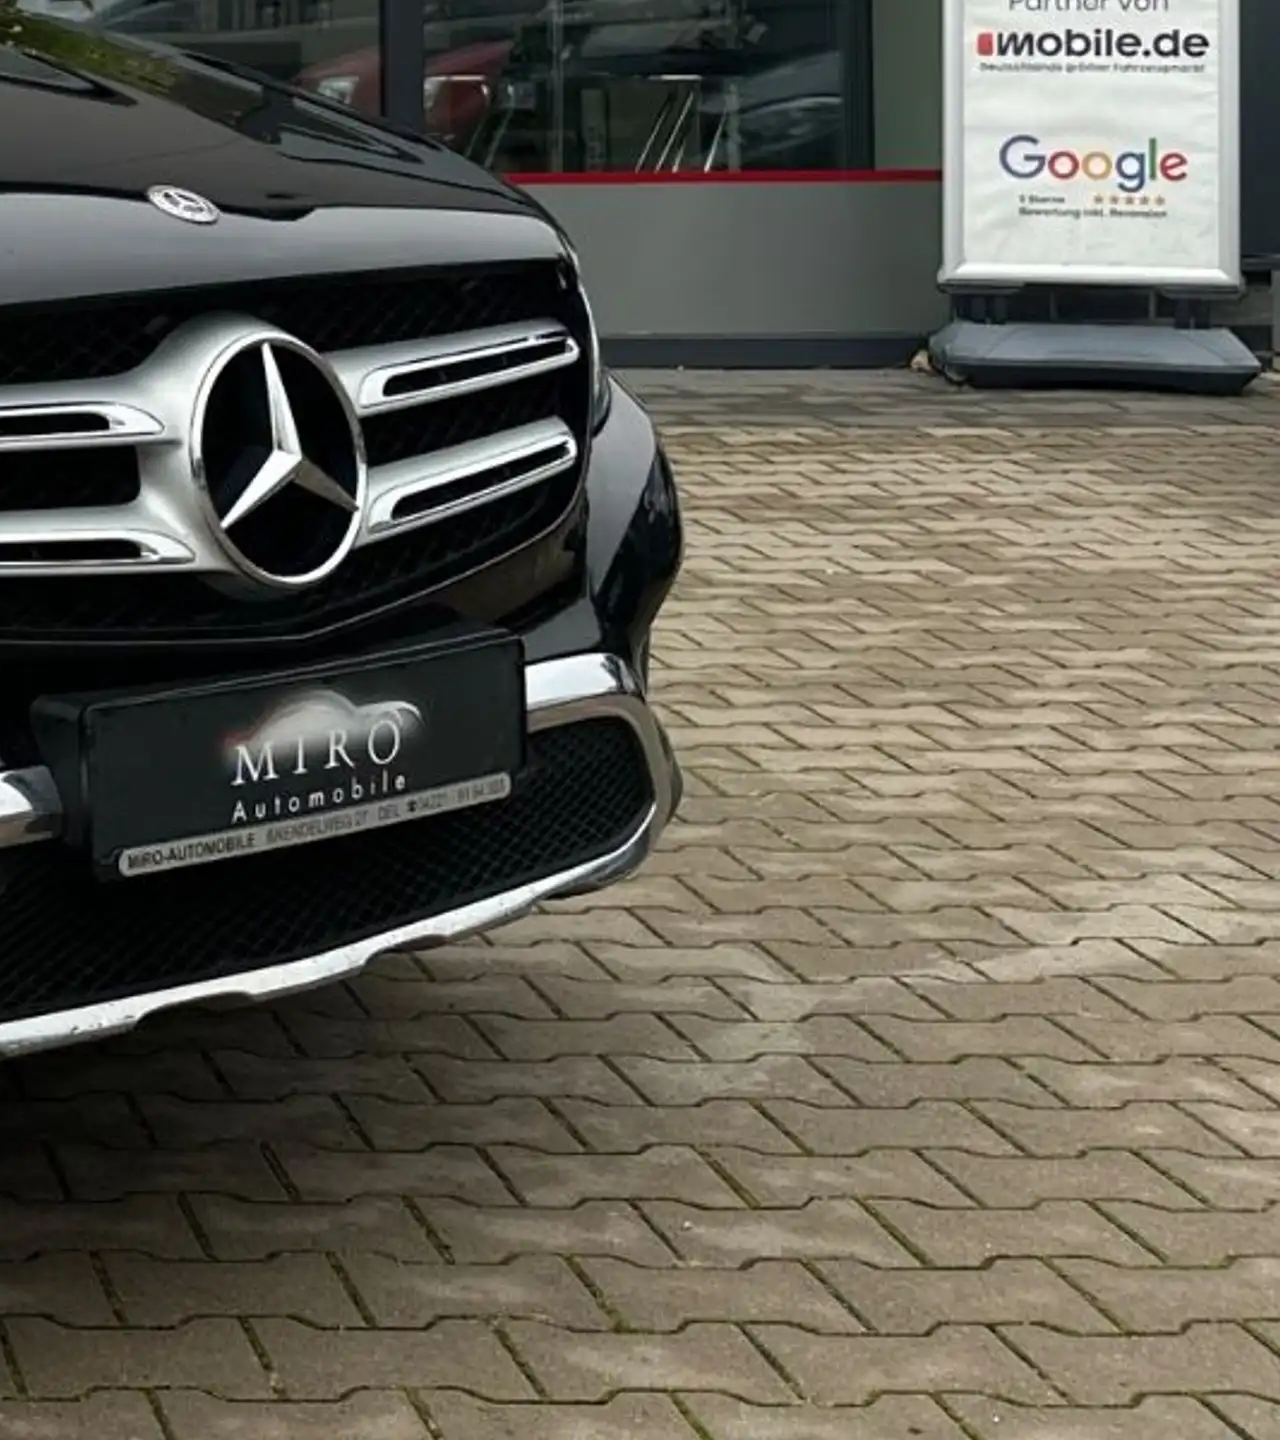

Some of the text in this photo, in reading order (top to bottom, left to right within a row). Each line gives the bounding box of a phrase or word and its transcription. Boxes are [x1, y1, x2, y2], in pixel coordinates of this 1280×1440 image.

[997, 29, 1210, 58] mobile.de
[999, 134, 1188, 193] Google
[230, 718, 403, 787] MIRO
[231, 769, 406, 824] Automobile
